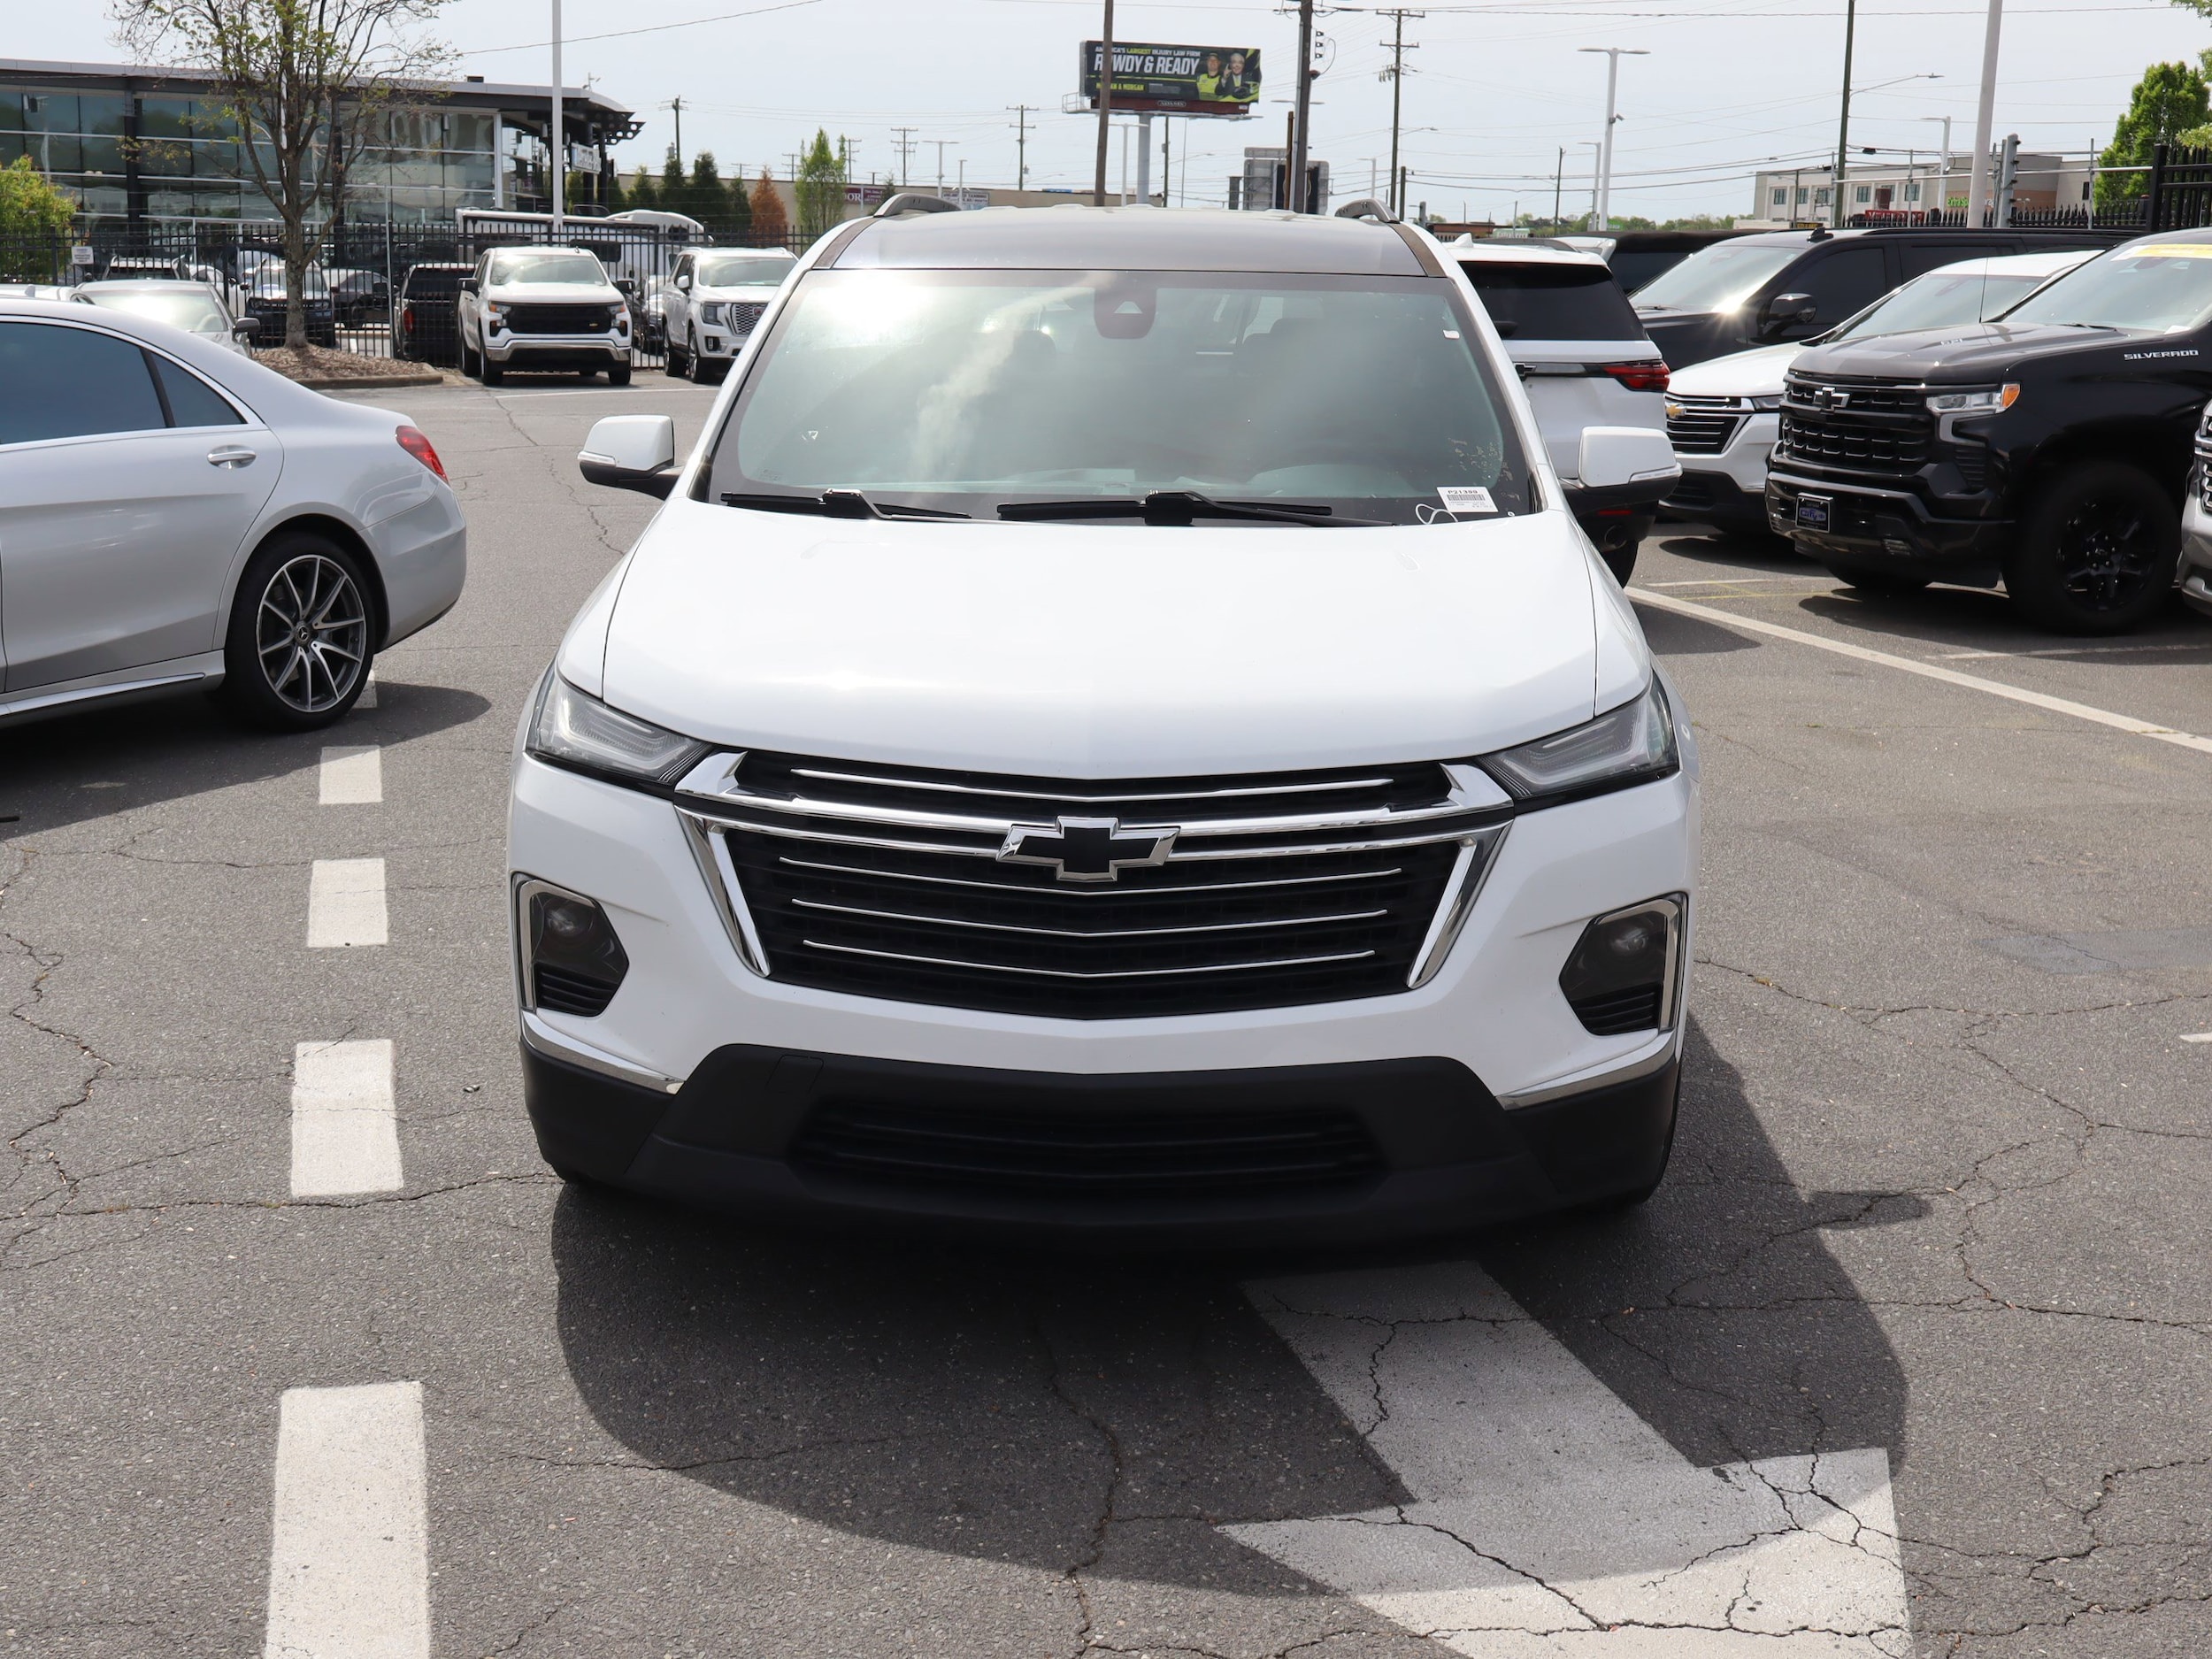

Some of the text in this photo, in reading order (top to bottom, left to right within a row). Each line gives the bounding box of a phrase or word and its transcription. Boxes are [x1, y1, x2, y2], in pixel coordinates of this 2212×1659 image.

[1094, 53, 1200, 75] RWDY & READY
[2124, 350, 2199, 361] SILVERADO
